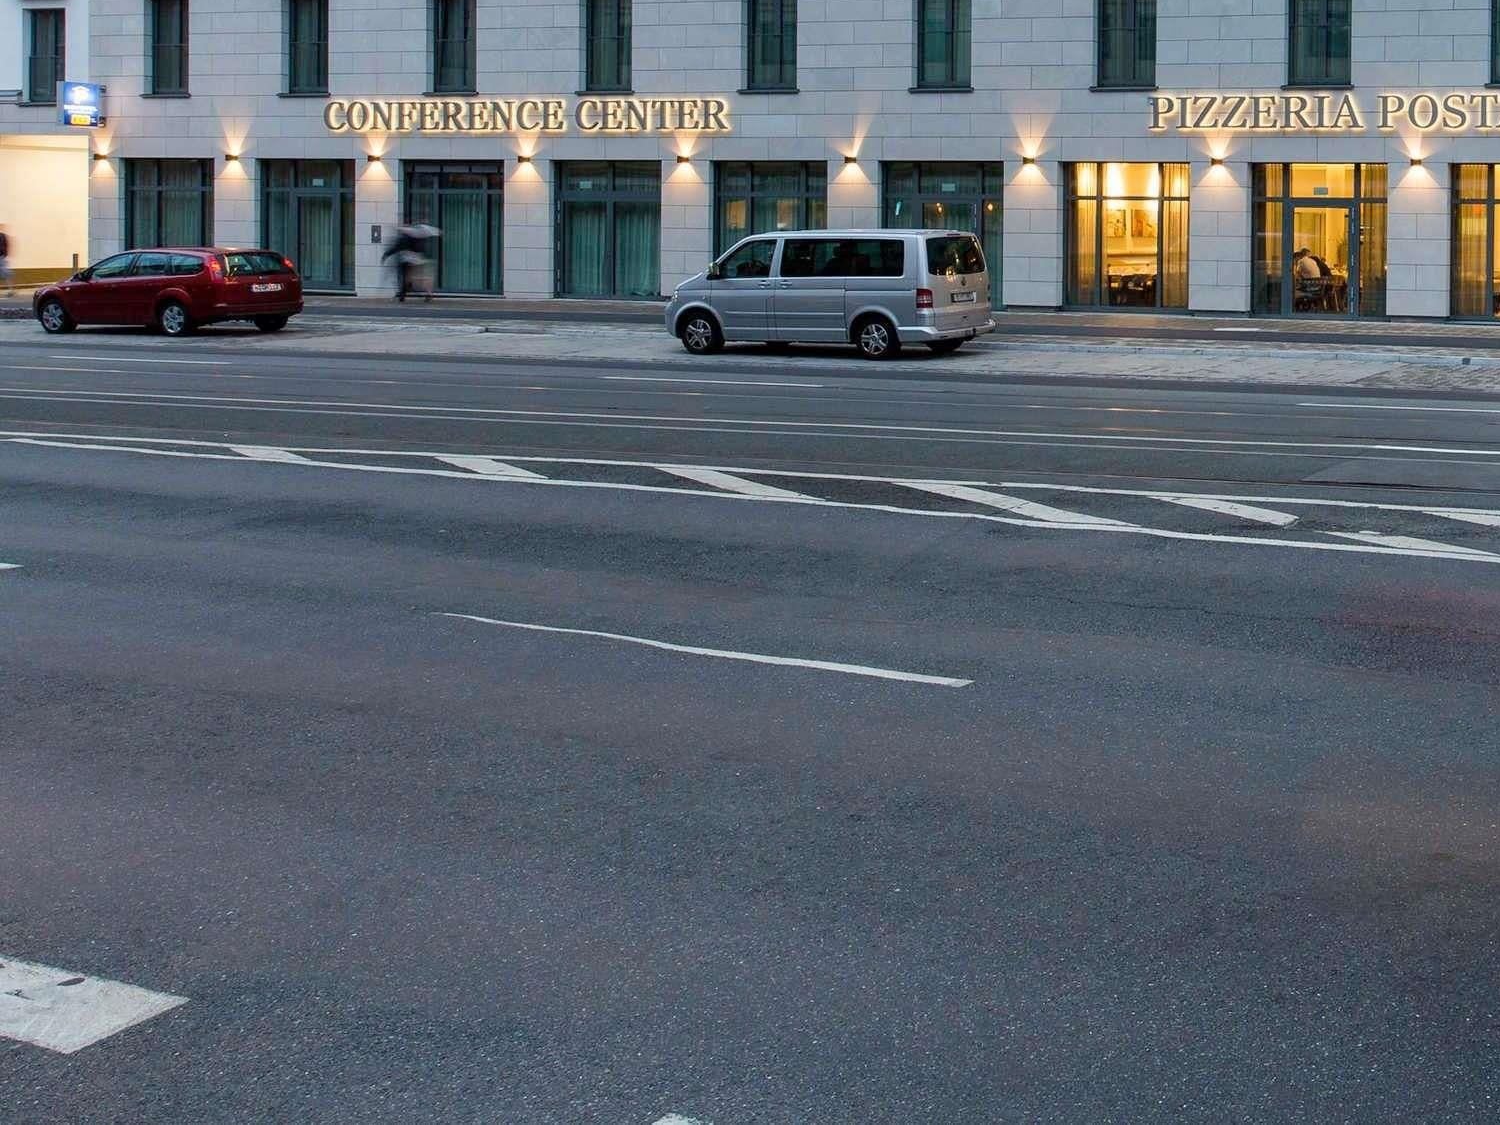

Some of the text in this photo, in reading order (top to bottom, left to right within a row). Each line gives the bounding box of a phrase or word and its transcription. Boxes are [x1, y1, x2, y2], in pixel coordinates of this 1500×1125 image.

[323, 99, 729, 131] CONFERENCE CENTER
[1150, 94, 1364, 129] PIZZERIA
